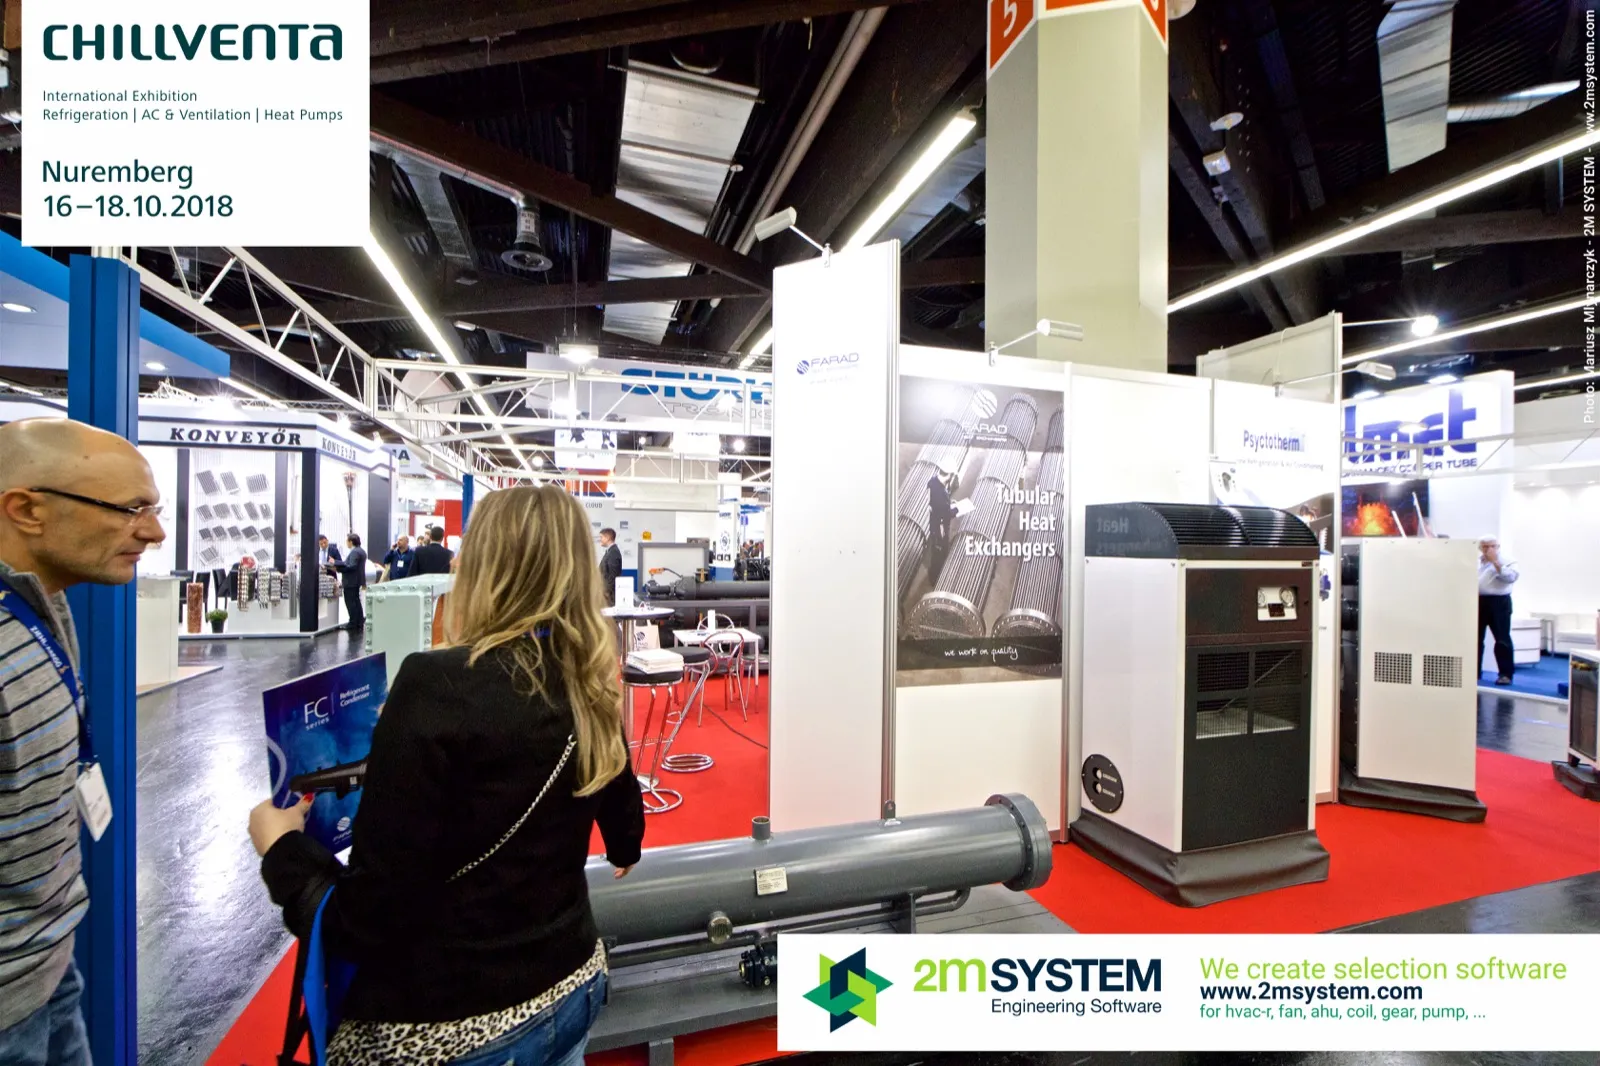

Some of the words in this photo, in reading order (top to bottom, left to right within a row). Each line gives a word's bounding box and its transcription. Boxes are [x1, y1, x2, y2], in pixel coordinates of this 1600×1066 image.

[811, 352, 859, 367] FARAD
[1243, 429, 1301, 453] Psyctotherm
[996, 484, 1055, 505] Tubular
[1019, 511, 1056, 531] Heat
[965, 536, 1056, 562] Exchangers
[944, 649, 956, 657] we
[958, 647, 977, 657] work
[979, 648, 989, 656] on
[991, 645, 1019, 663] quality
[304, 696, 329, 724] FC
